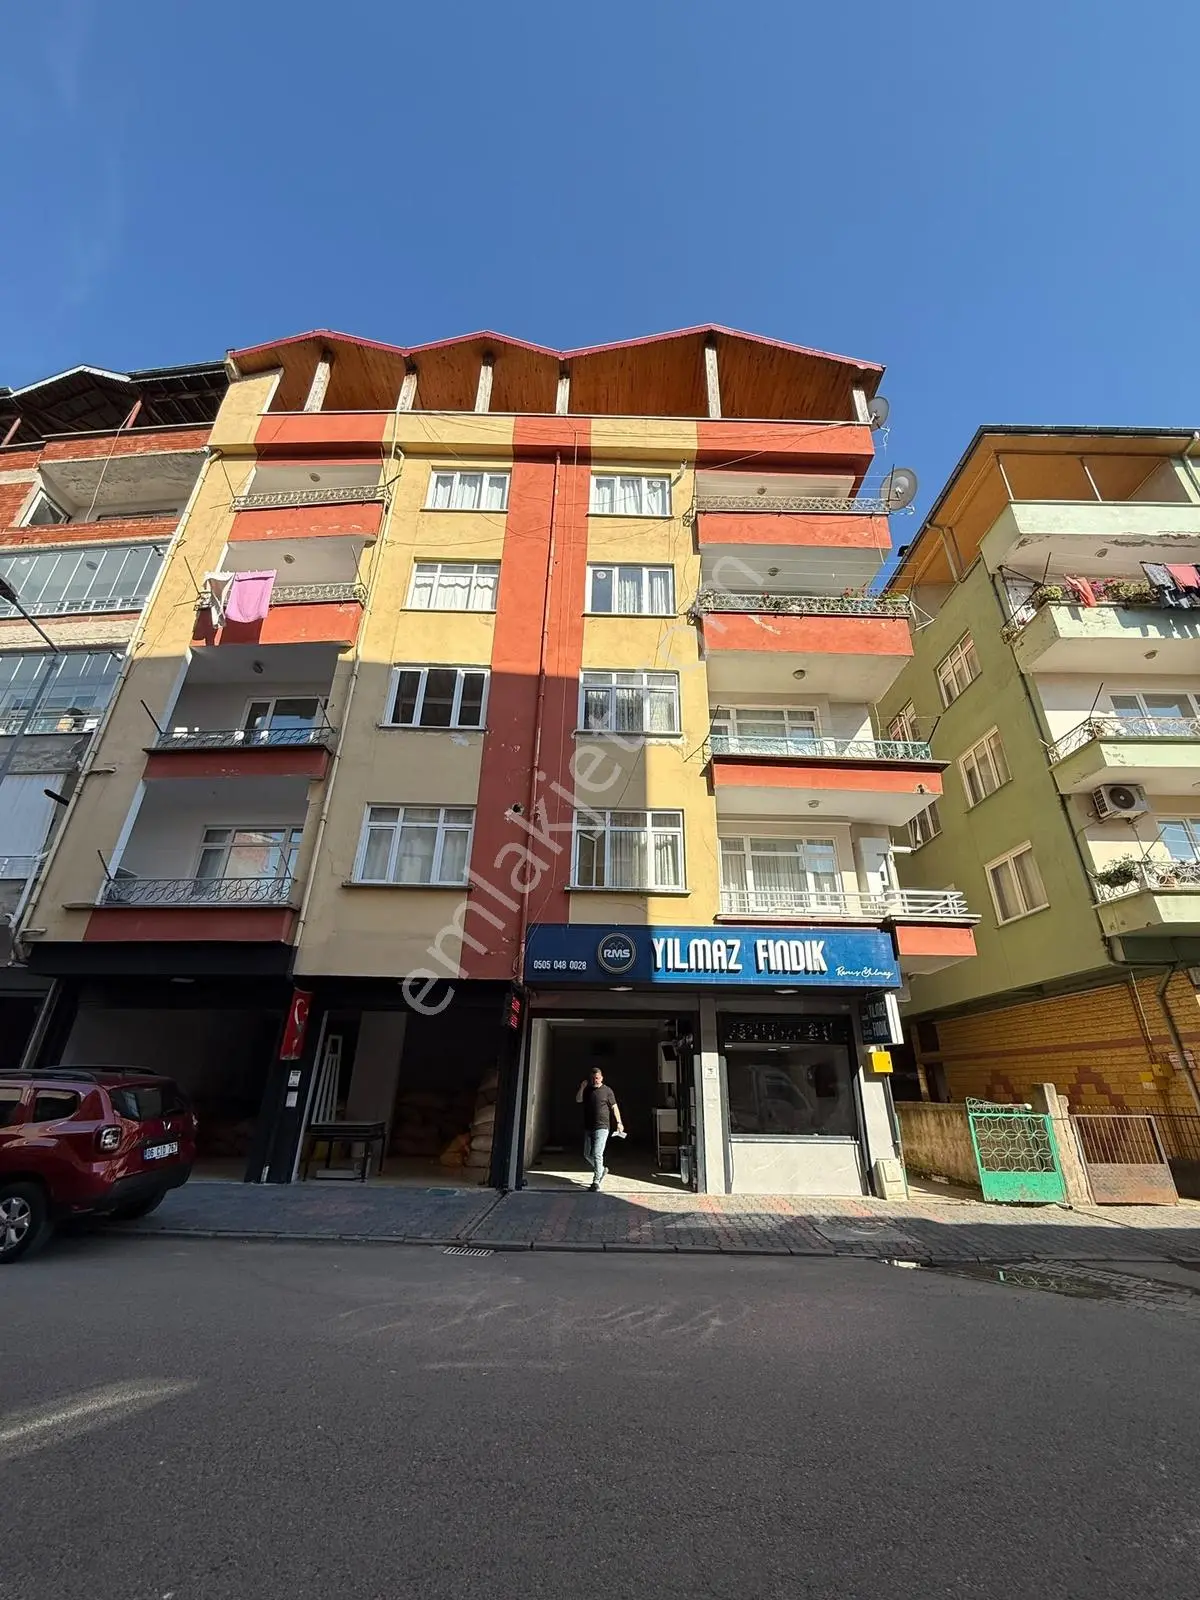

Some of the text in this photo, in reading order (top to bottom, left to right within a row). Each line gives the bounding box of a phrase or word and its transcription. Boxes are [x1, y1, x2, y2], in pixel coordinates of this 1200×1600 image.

[603, 949, 631, 958] RMS
[653, 938, 828, 973] YILMAZ FINDIK
[533, 960, 587, 970] 0505 048 0028
